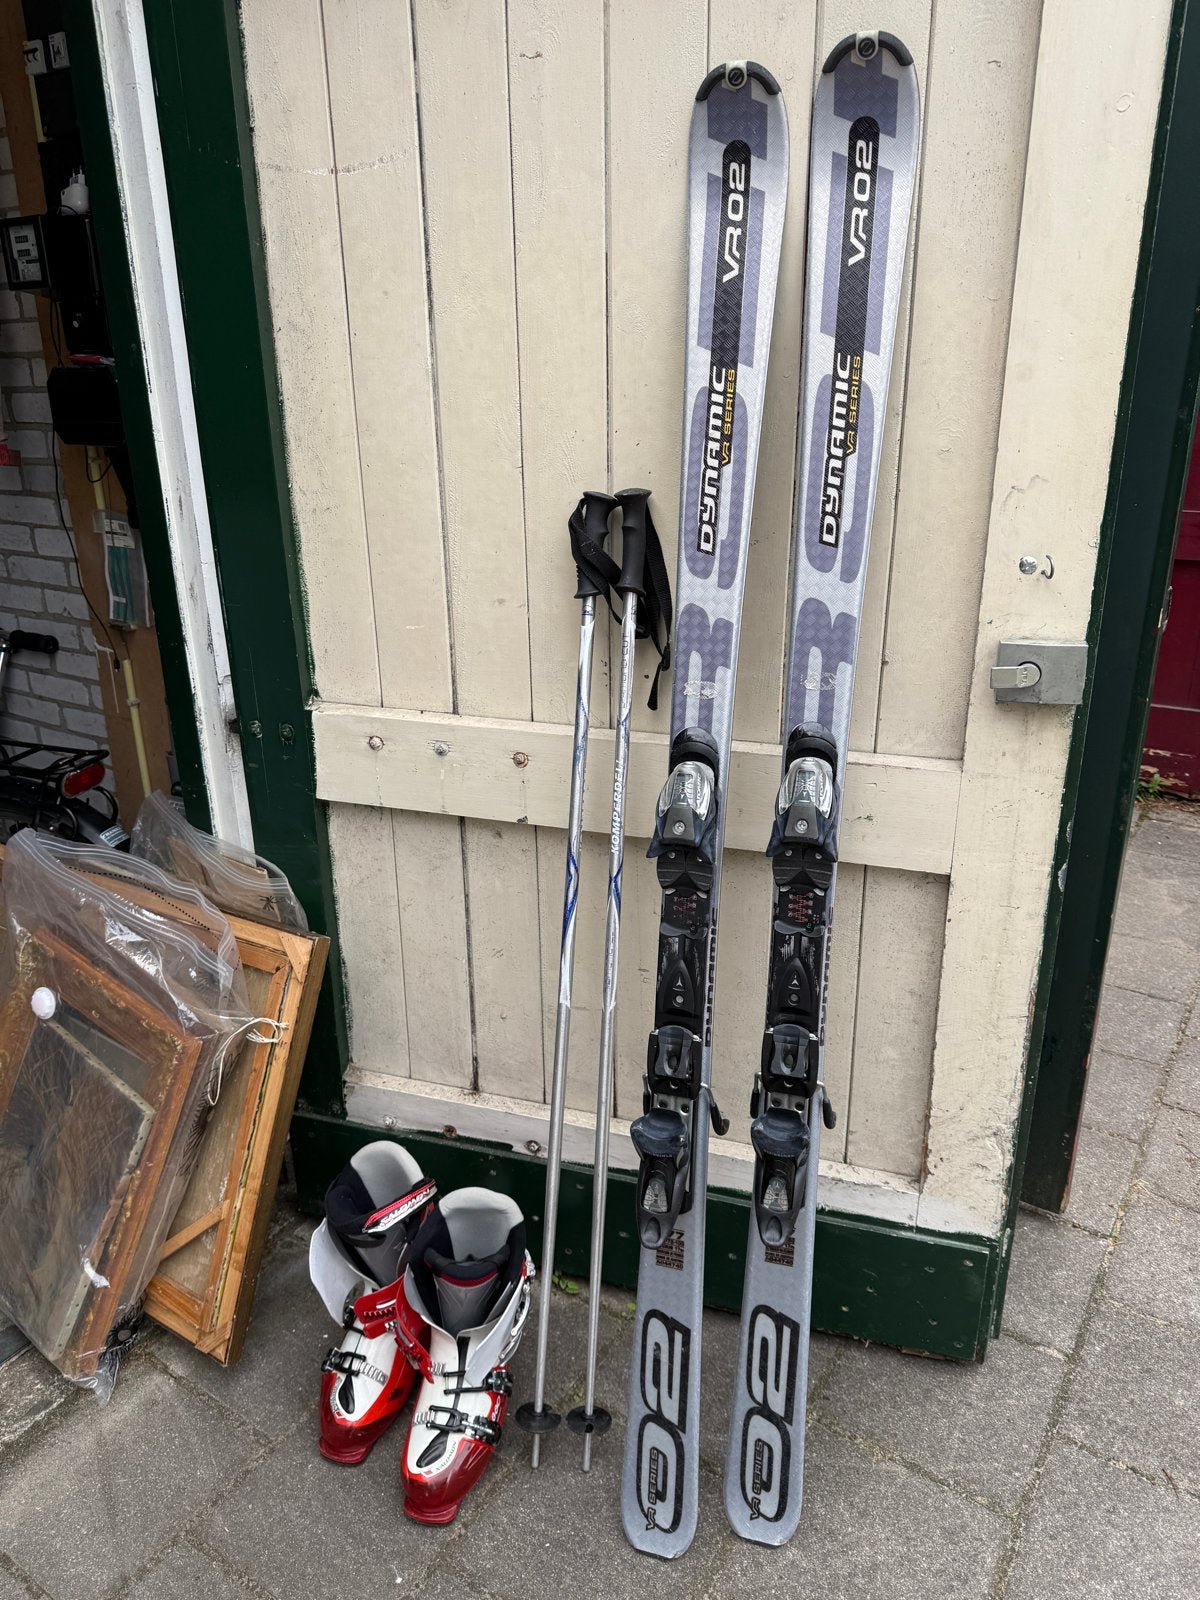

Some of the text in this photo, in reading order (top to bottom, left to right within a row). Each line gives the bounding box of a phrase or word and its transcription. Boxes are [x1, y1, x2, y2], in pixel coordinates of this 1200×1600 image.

[722, 369, 736, 465] VR SERIES
[821, 352, 851, 546] DYNAMIC
[846, 356, 861, 453] VR SERIES
[699, 365, 727, 553] DYNAMIC
[610, 760, 624, 855] KOMPERDELL
[380, 1188, 430, 1225] SALOMON
[645, 1448, 660, 1531] VR SERIES
[750, 1438, 764, 1521] VR SERIES
